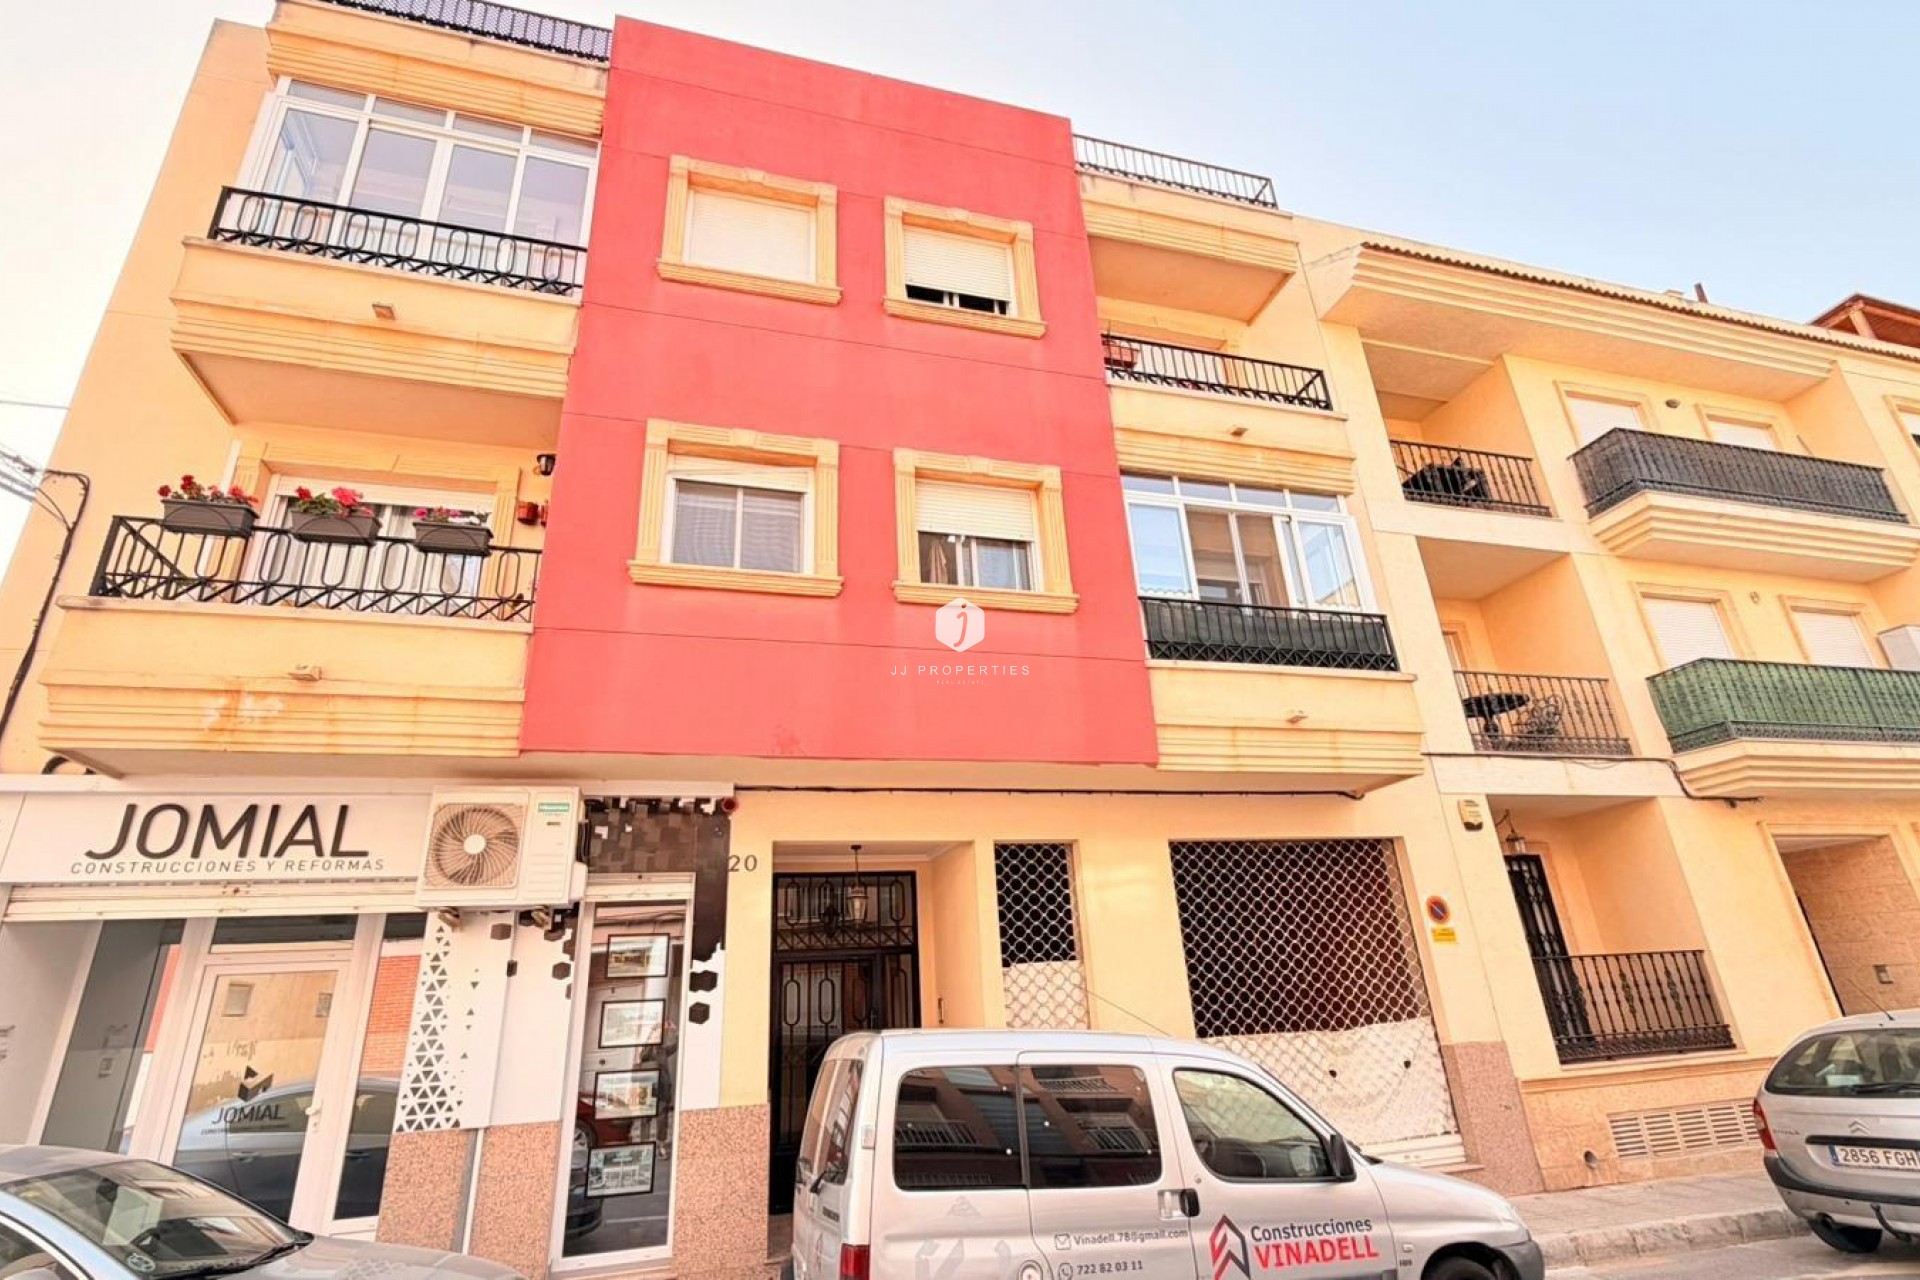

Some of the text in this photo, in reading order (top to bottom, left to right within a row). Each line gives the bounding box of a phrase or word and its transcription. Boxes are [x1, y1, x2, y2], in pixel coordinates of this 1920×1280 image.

[85, 802, 370, 860] JOMIAL
[71, 858, 385, 875] CONSTRUCCIONES Y REFORMAS
[727, 854, 758, 873] 20
[211, 1104, 287, 1125] JOMIAL
[1840, 1148, 1918, 1167] 2856 FGH
[1251, 1218, 1373, 1242] Construcciones
[1254, 1235, 1380, 1270] VINADELL
[1077, 1264, 1097, 1275] 722
[1131, 1260, 1144, 1271] 11
